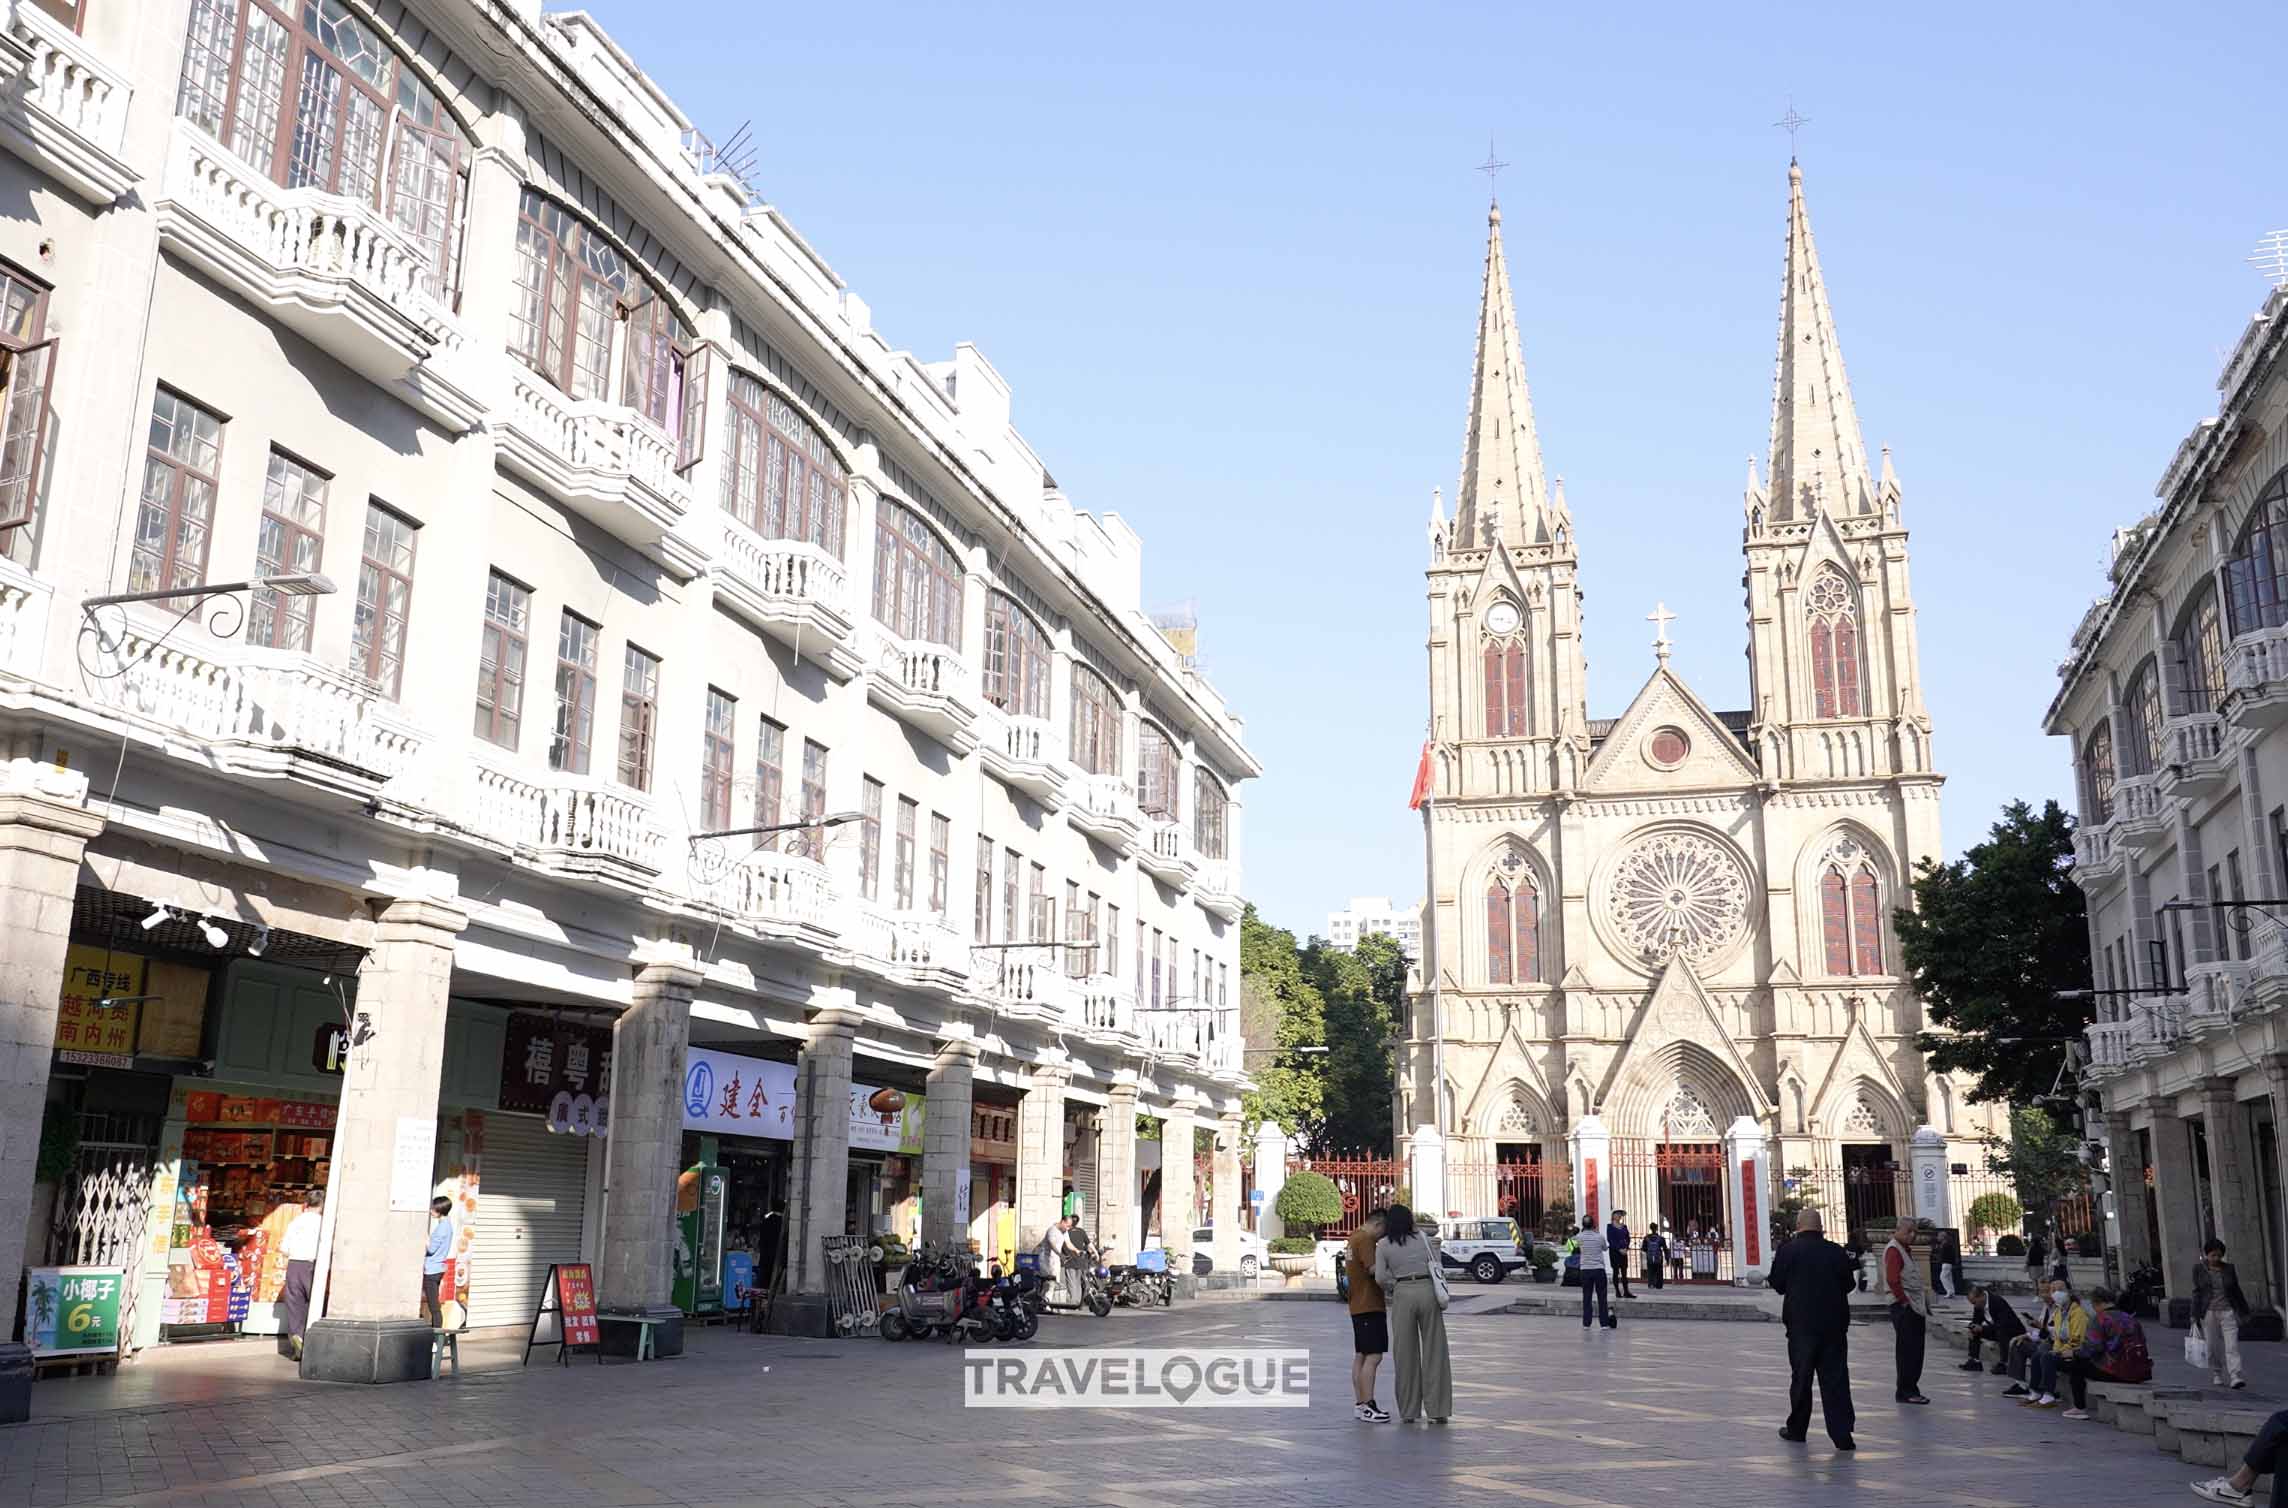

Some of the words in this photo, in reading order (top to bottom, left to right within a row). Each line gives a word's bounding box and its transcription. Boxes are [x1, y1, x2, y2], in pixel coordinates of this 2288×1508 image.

[720, 1070, 769, 1119] 建全
[63, 1279, 115, 1301] 小椰子
